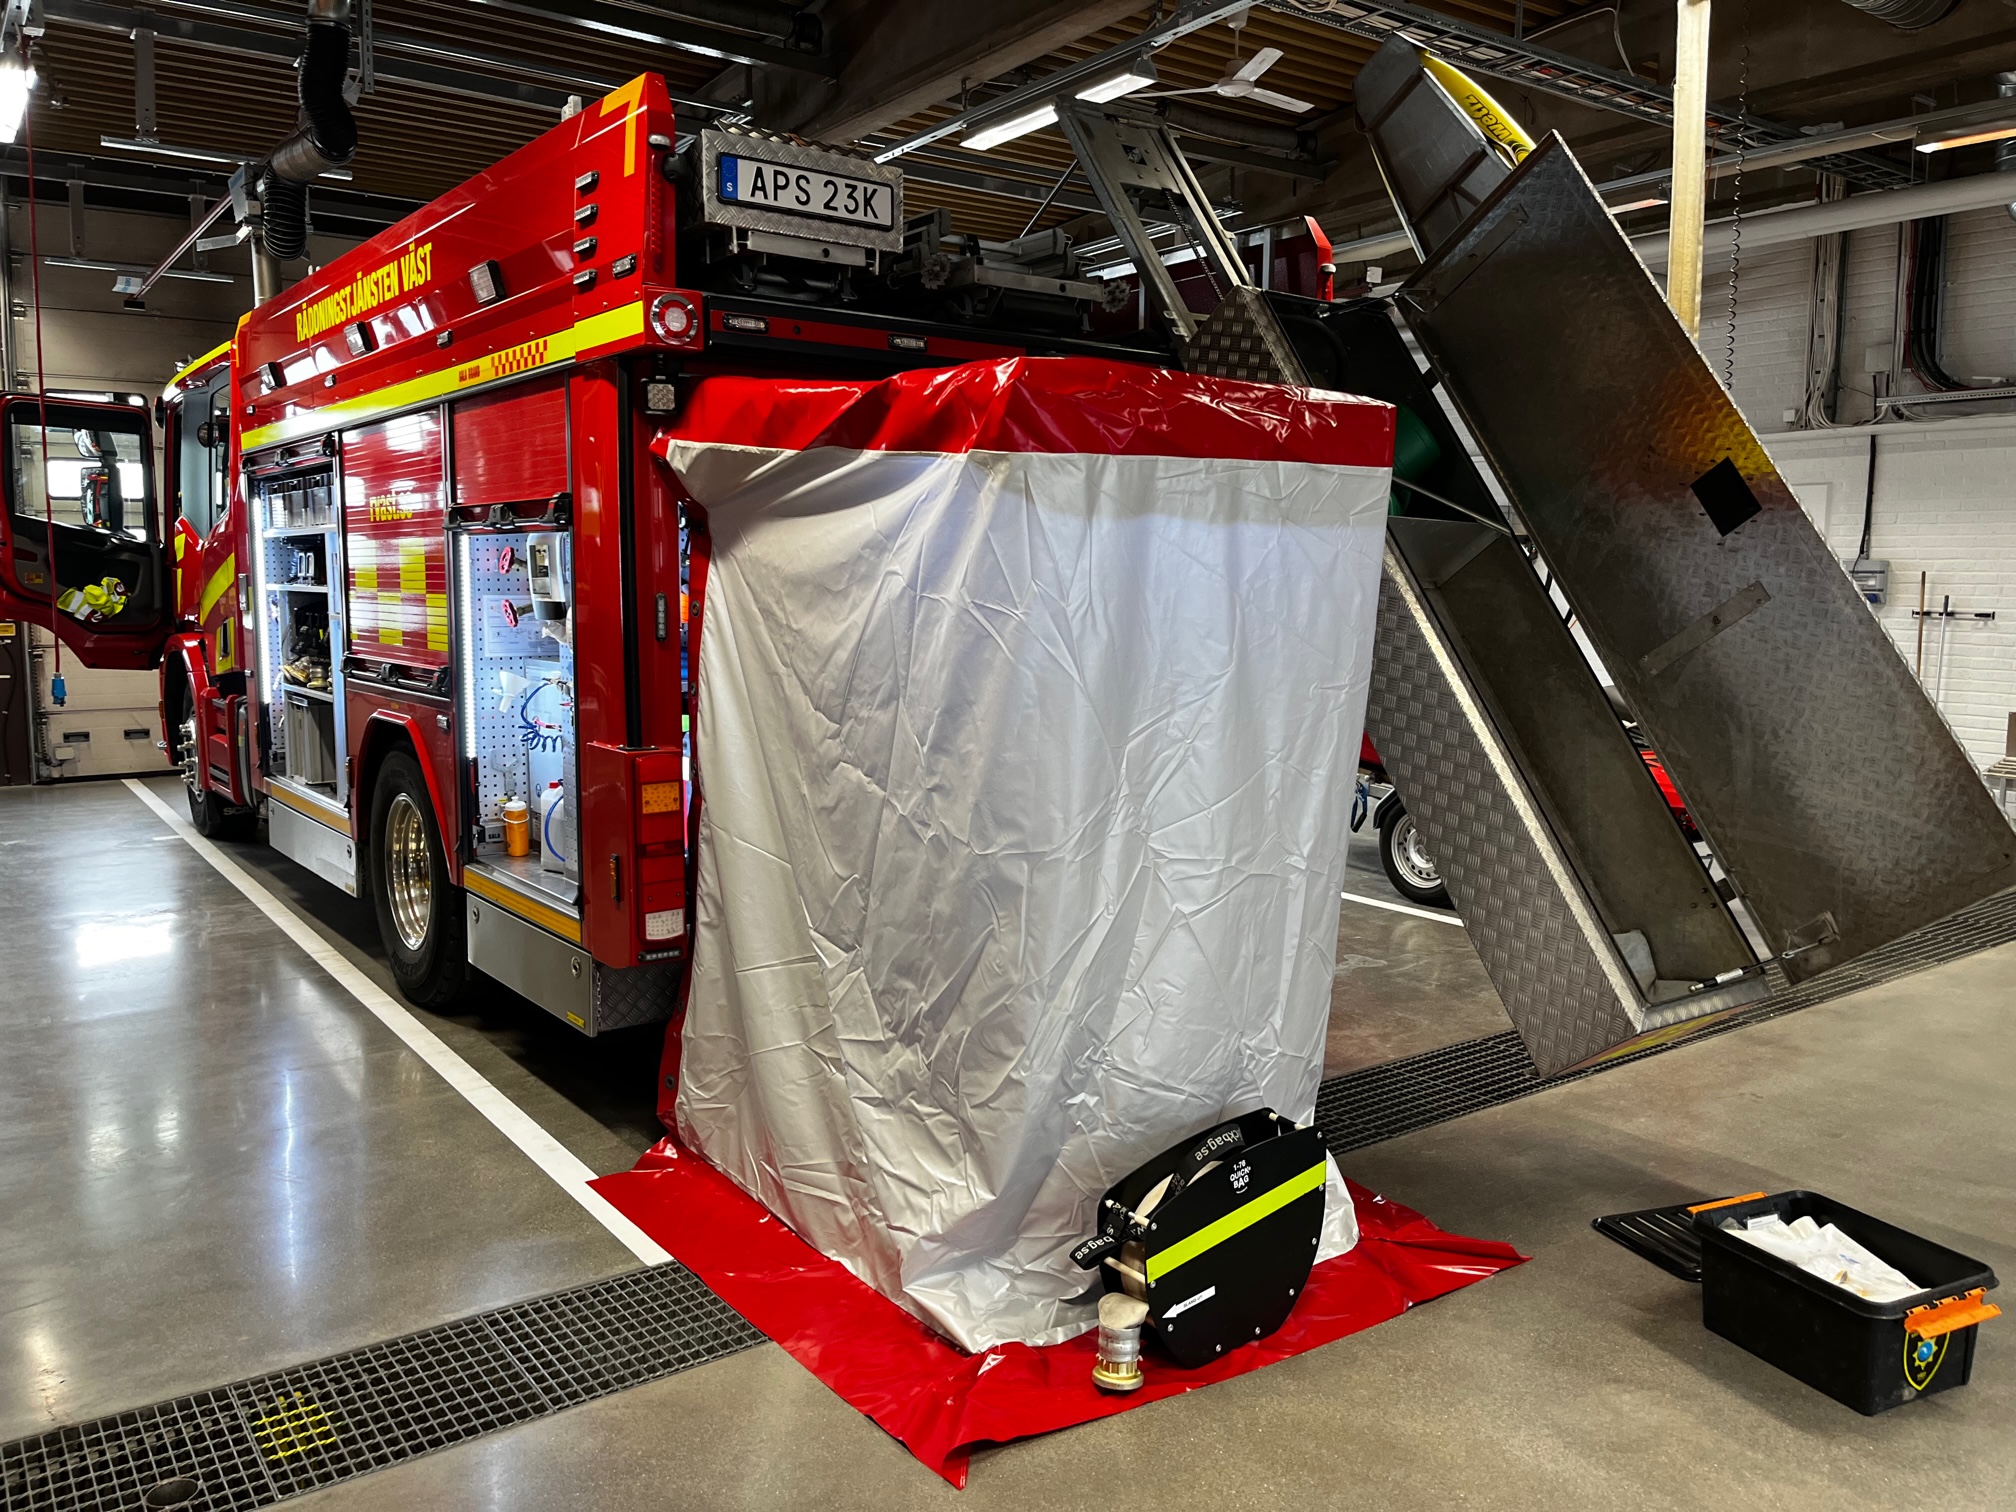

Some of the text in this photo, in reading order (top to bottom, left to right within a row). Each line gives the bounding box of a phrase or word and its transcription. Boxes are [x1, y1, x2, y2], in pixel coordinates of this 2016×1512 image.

[726, 182, 734, 192] S
[750, 166, 879, 220] APS 23K
[296, 242, 432, 343] RÄDDNINGSTJÄNSTEN VÄST
[1233, 1174, 1249, 1189] BAG
